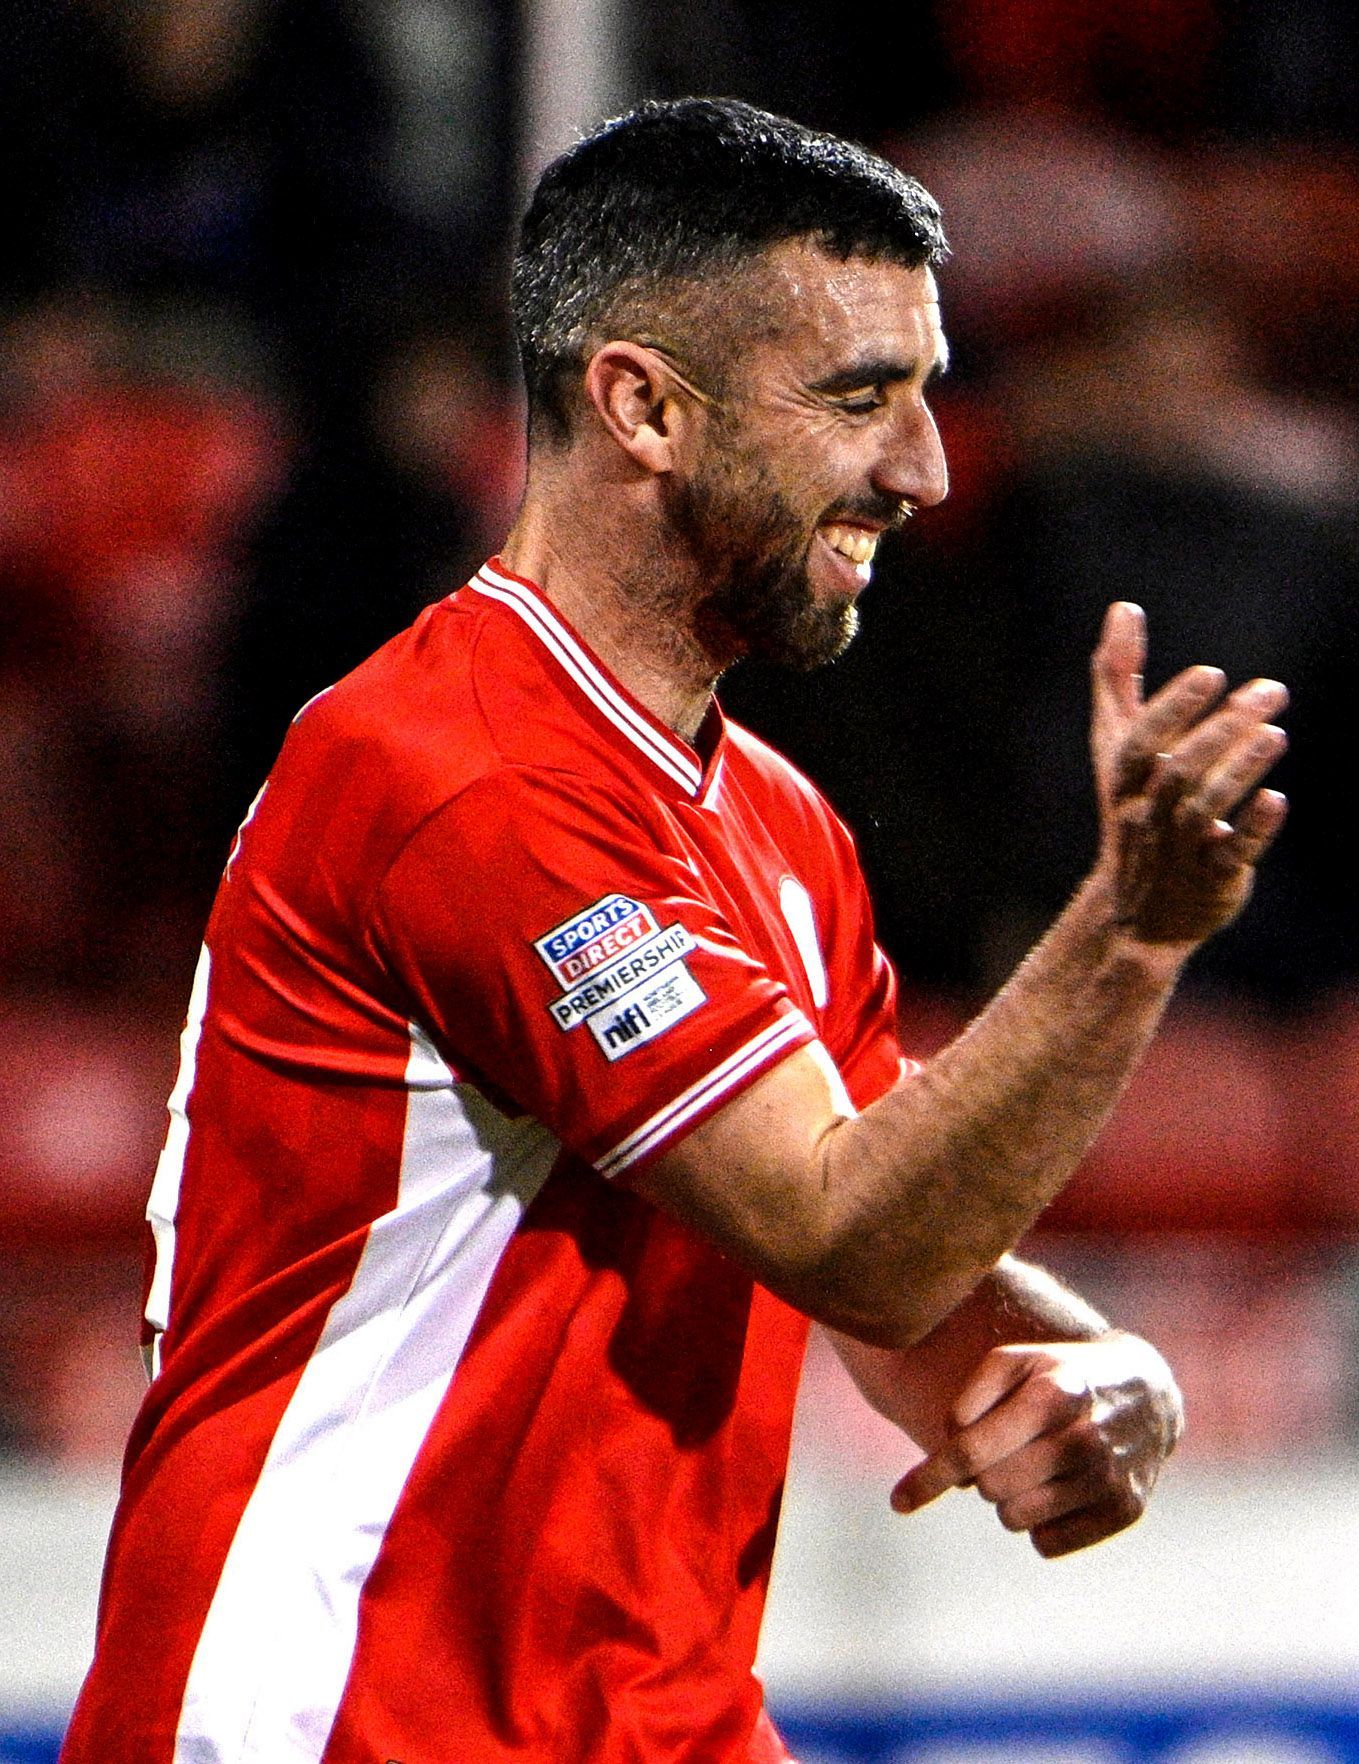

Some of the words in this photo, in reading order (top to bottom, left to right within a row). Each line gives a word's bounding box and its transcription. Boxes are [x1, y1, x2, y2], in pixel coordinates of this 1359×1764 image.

[550, 897, 635, 957] SPORTS
[566, 916, 645, 978] DIRECT
[555, 930, 686, 1024] PREMIERSHIP
[602, 1003, 651, 1049] nifl
